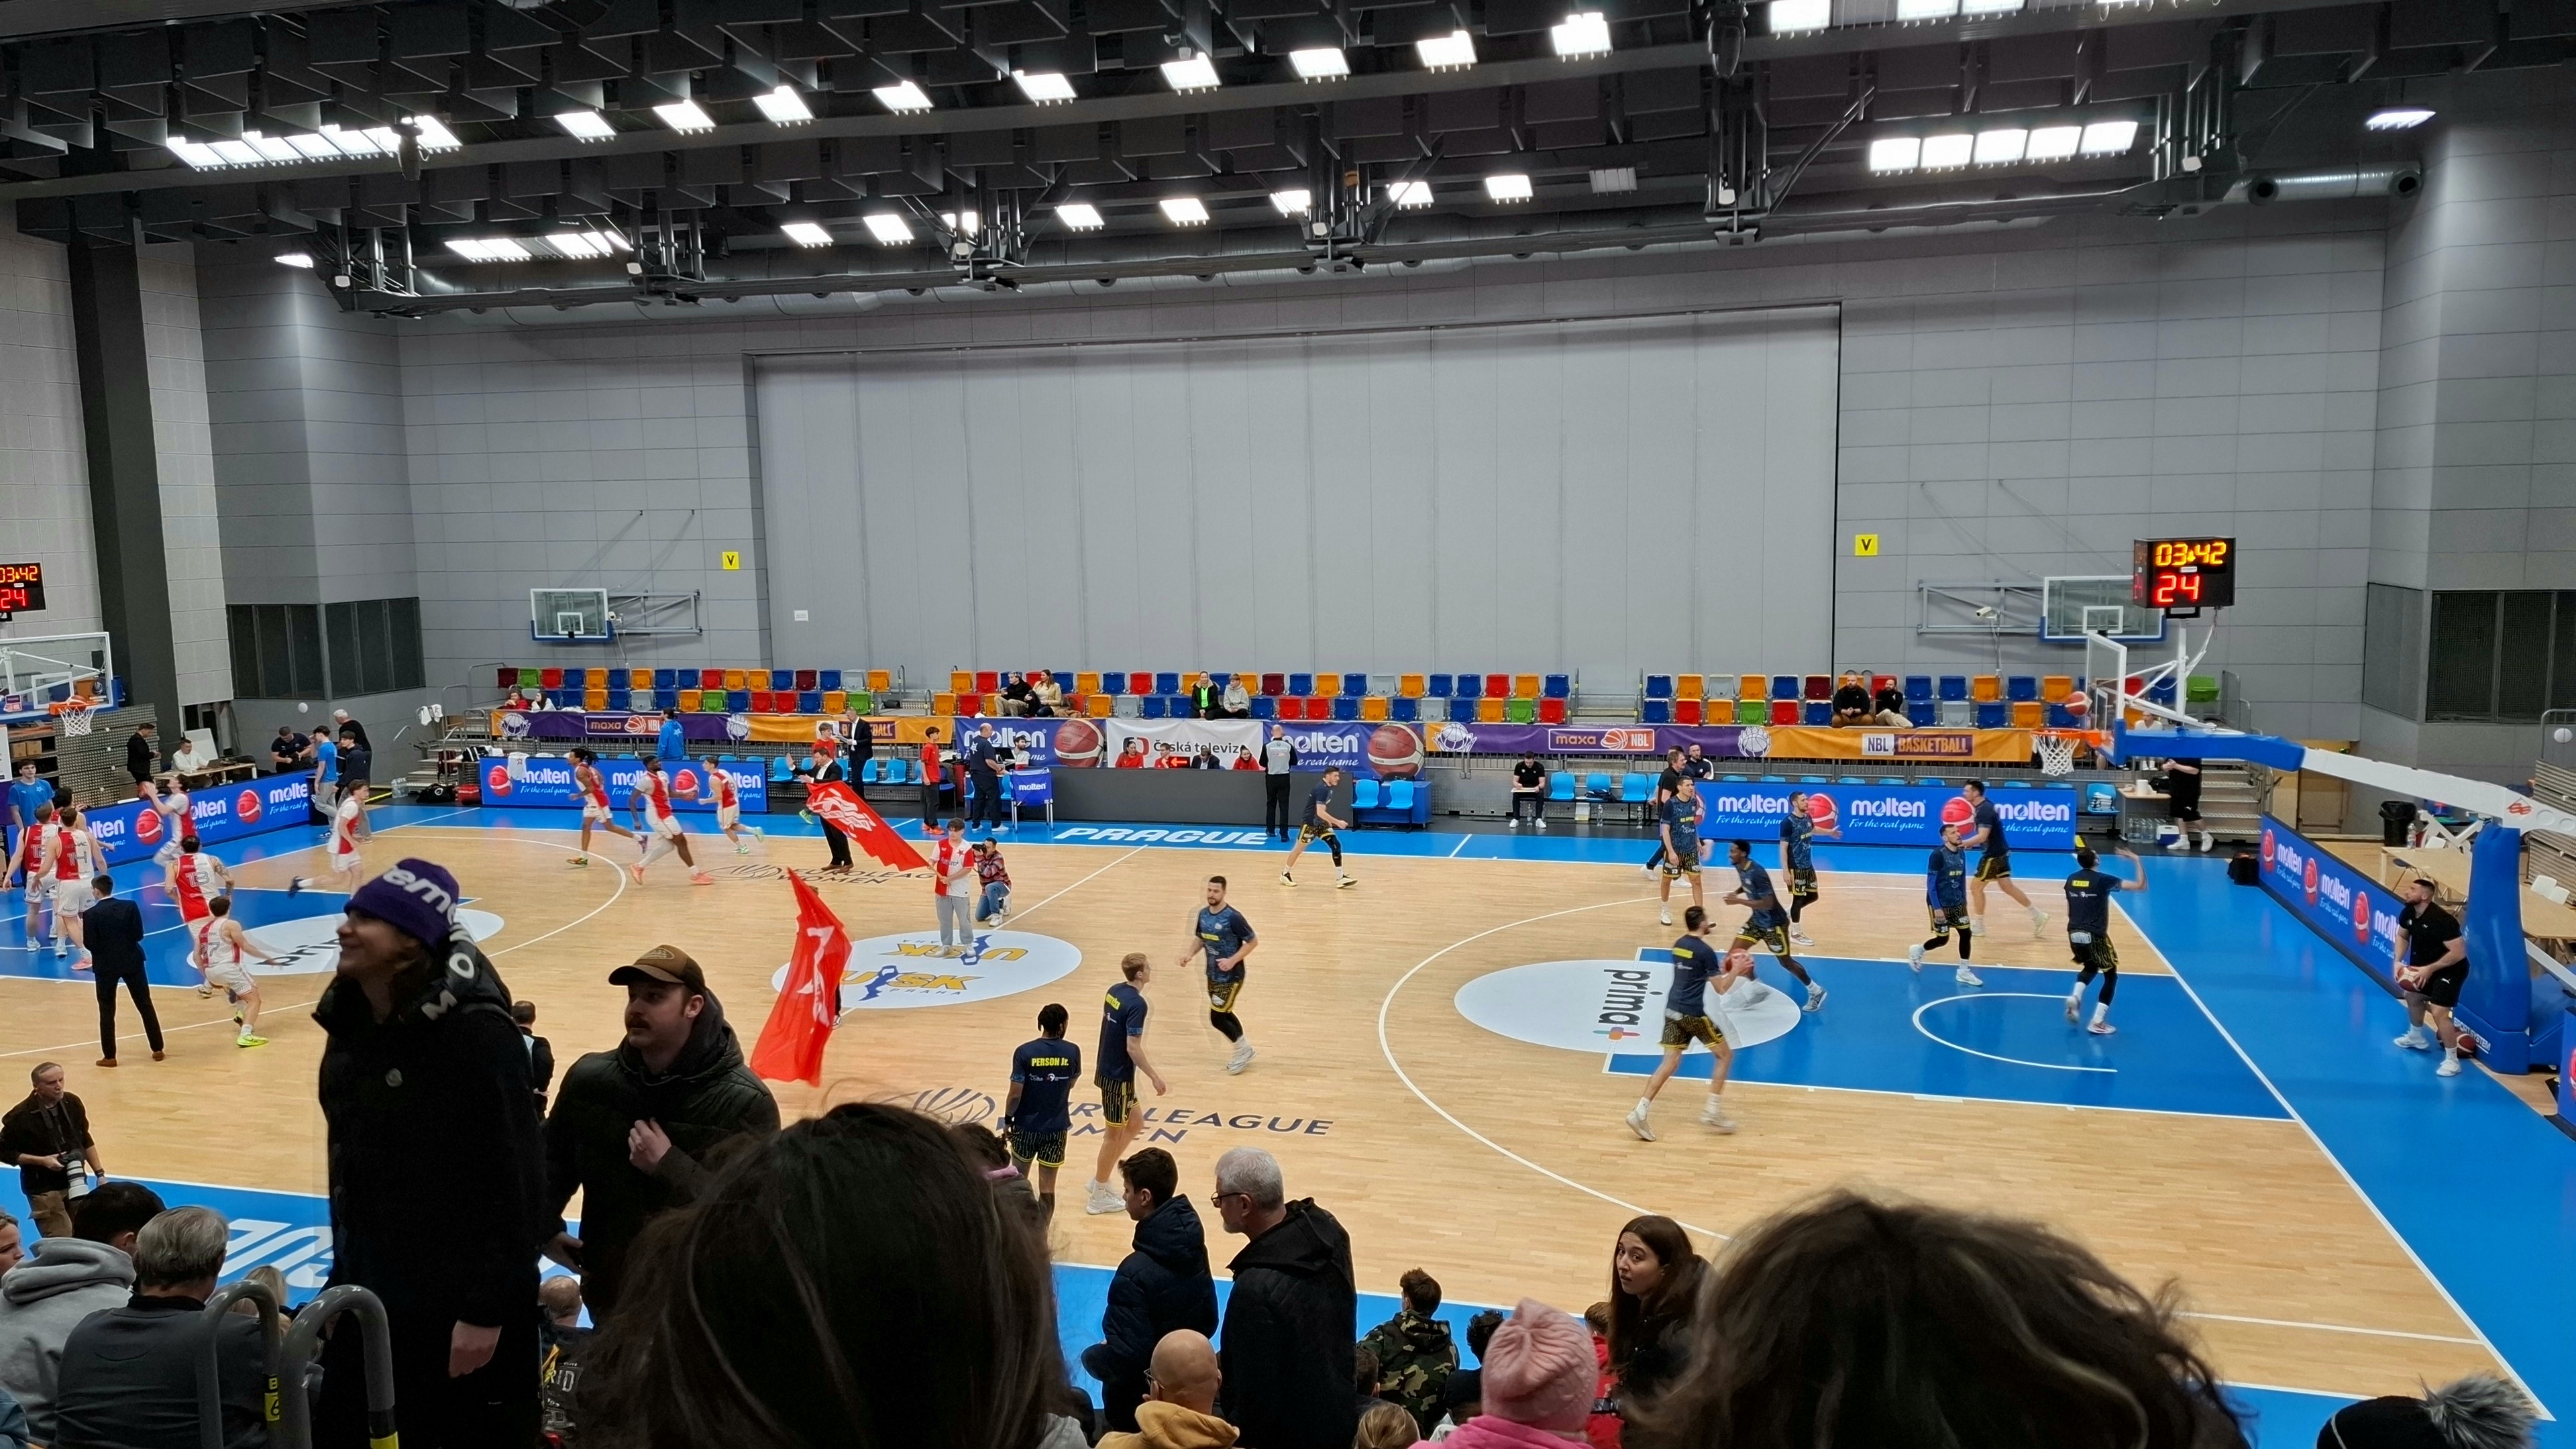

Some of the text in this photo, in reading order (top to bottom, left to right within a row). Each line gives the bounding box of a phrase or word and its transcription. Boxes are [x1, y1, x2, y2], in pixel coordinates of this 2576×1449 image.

[1861, 538, 1872, 551] V
[727, 555, 735, 566] V
[2157, 575, 2200, 602] 24
[1, 589, 25, 608] 24
[591, 721, 621, 730] maxa
[1153, 739, 1239, 754] Čská televiz
[1556, 733, 1649, 747] maxa NBL
[1868, 737, 1969, 753] NBL BASKETBALL
[270, 782, 308, 804] molte
[1018, 782, 1046, 791] molten
[1718, 794, 1789, 814] molten
[1851, 797, 1925, 817] molten
[1994, 801, 2070, 821] molten
[1716, 815, 1782, 828] For the real gam
[1849, 818, 1925, 831] For the real game
[2022, 822, 2042, 833] real
[2042, 826, 2070, 836] game
[1053, 828, 1269, 845] PRAGUE
[2277, 843, 2303, 876] molten
[2322, 873, 2350, 910] molten
[1031, 1057, 1069, 1067] PERSON Jr.
